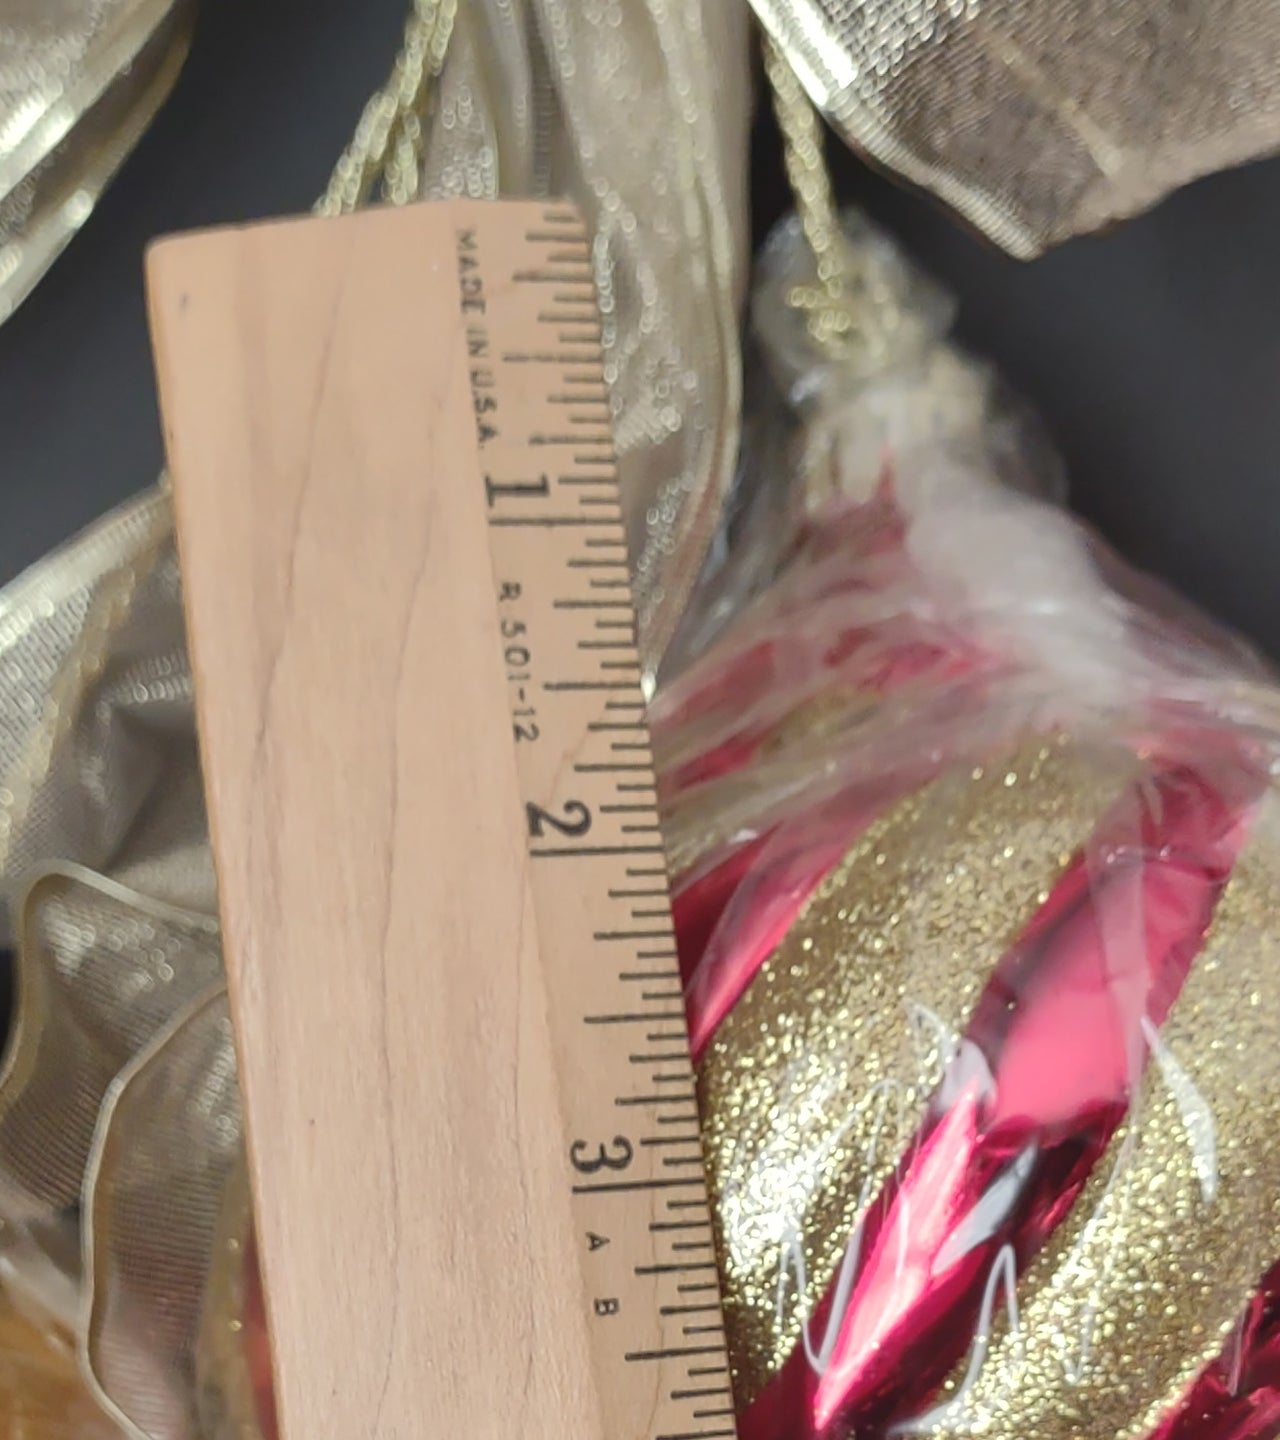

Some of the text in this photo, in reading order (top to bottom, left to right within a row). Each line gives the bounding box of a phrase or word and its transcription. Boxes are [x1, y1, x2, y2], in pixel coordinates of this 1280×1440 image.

[456, 227, 486, 315] MADE
[466, 327, 489, 357] IN
[484, 473, 550, 508] 1
[525, 799, 593, 838] 2
[570, 1135, 634, 1174] 3
[585, 1232, 619, 1316] A B
